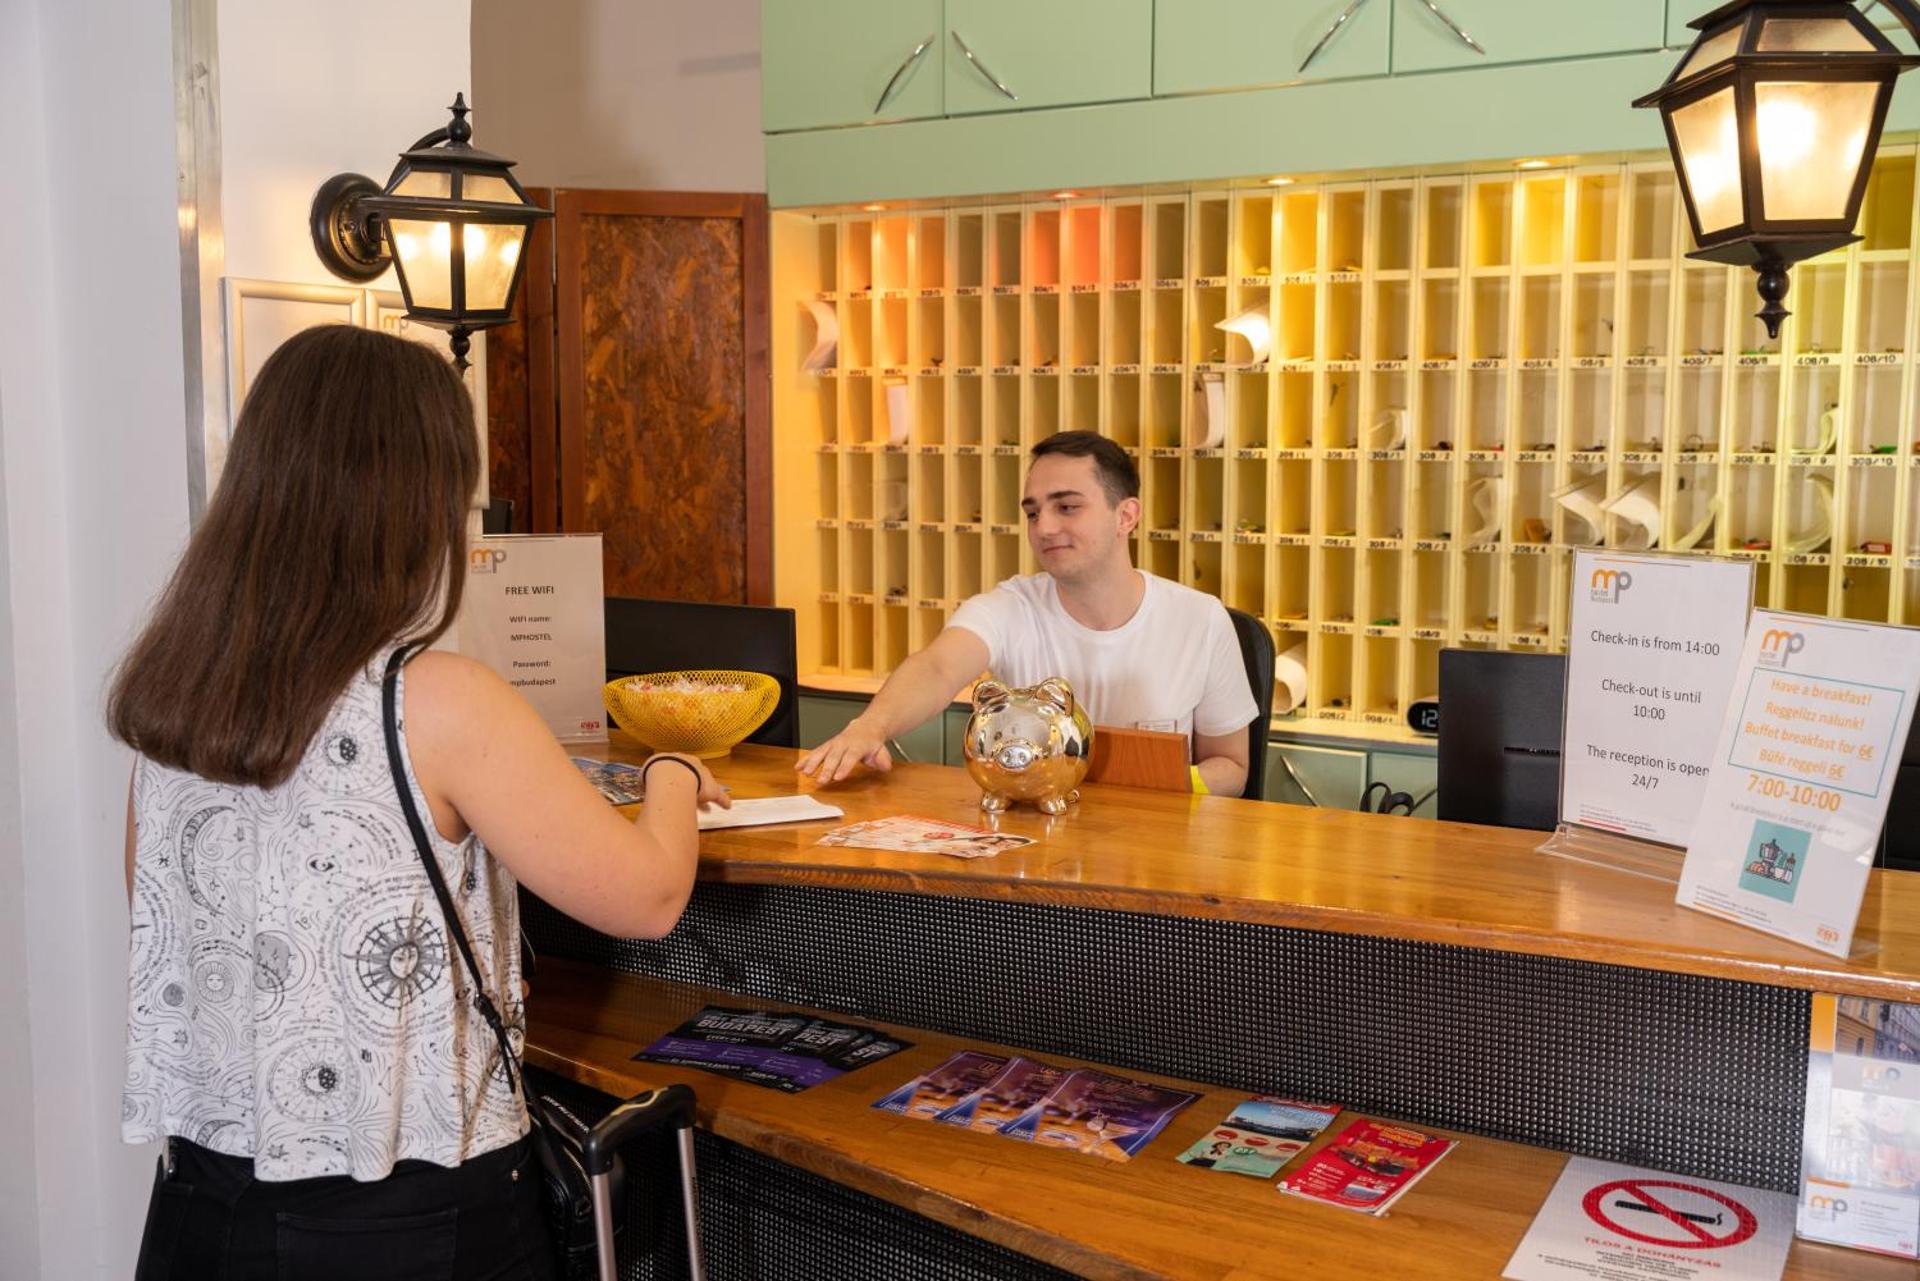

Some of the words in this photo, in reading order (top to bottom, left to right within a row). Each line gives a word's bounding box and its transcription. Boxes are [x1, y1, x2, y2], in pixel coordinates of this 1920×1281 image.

[1790, 555, 1826, 564] 08/9
[505, 586, 529, 595] FREE
[531, 586, 554, 595] WIFI
[1591, 630, 1638, 646] Check-in
[1641, 633, 1651, 648] is
[1654, 636, 1682, 652] from
[1686, 641, 1720, 656] 14:00
[512, 660, 552, 668] Password:
[1602, 679, 1658, 698] Check-out
[1662, 687, 1671, 700] is
[1674, 691, 1702, 704] until
[1771, 679, 1801, 695] Have
[1812, 684, 1872, 706] breakfast!
[1633, 705, 1665, 720] 10:00
[1746, 721, 1779, 739] Buffet
[1781, 728, 1836, 751] breakfast
[1838, 740, 1856, 754] for
[1587, 744, 1607, 758] The
[1609, 749, 1664, 769] reception
[1666, 759, 1677, 771] is
[1631, 773, 1659, 790] 24/7
[697, 1018, 794, 1036] BUDAPEST
